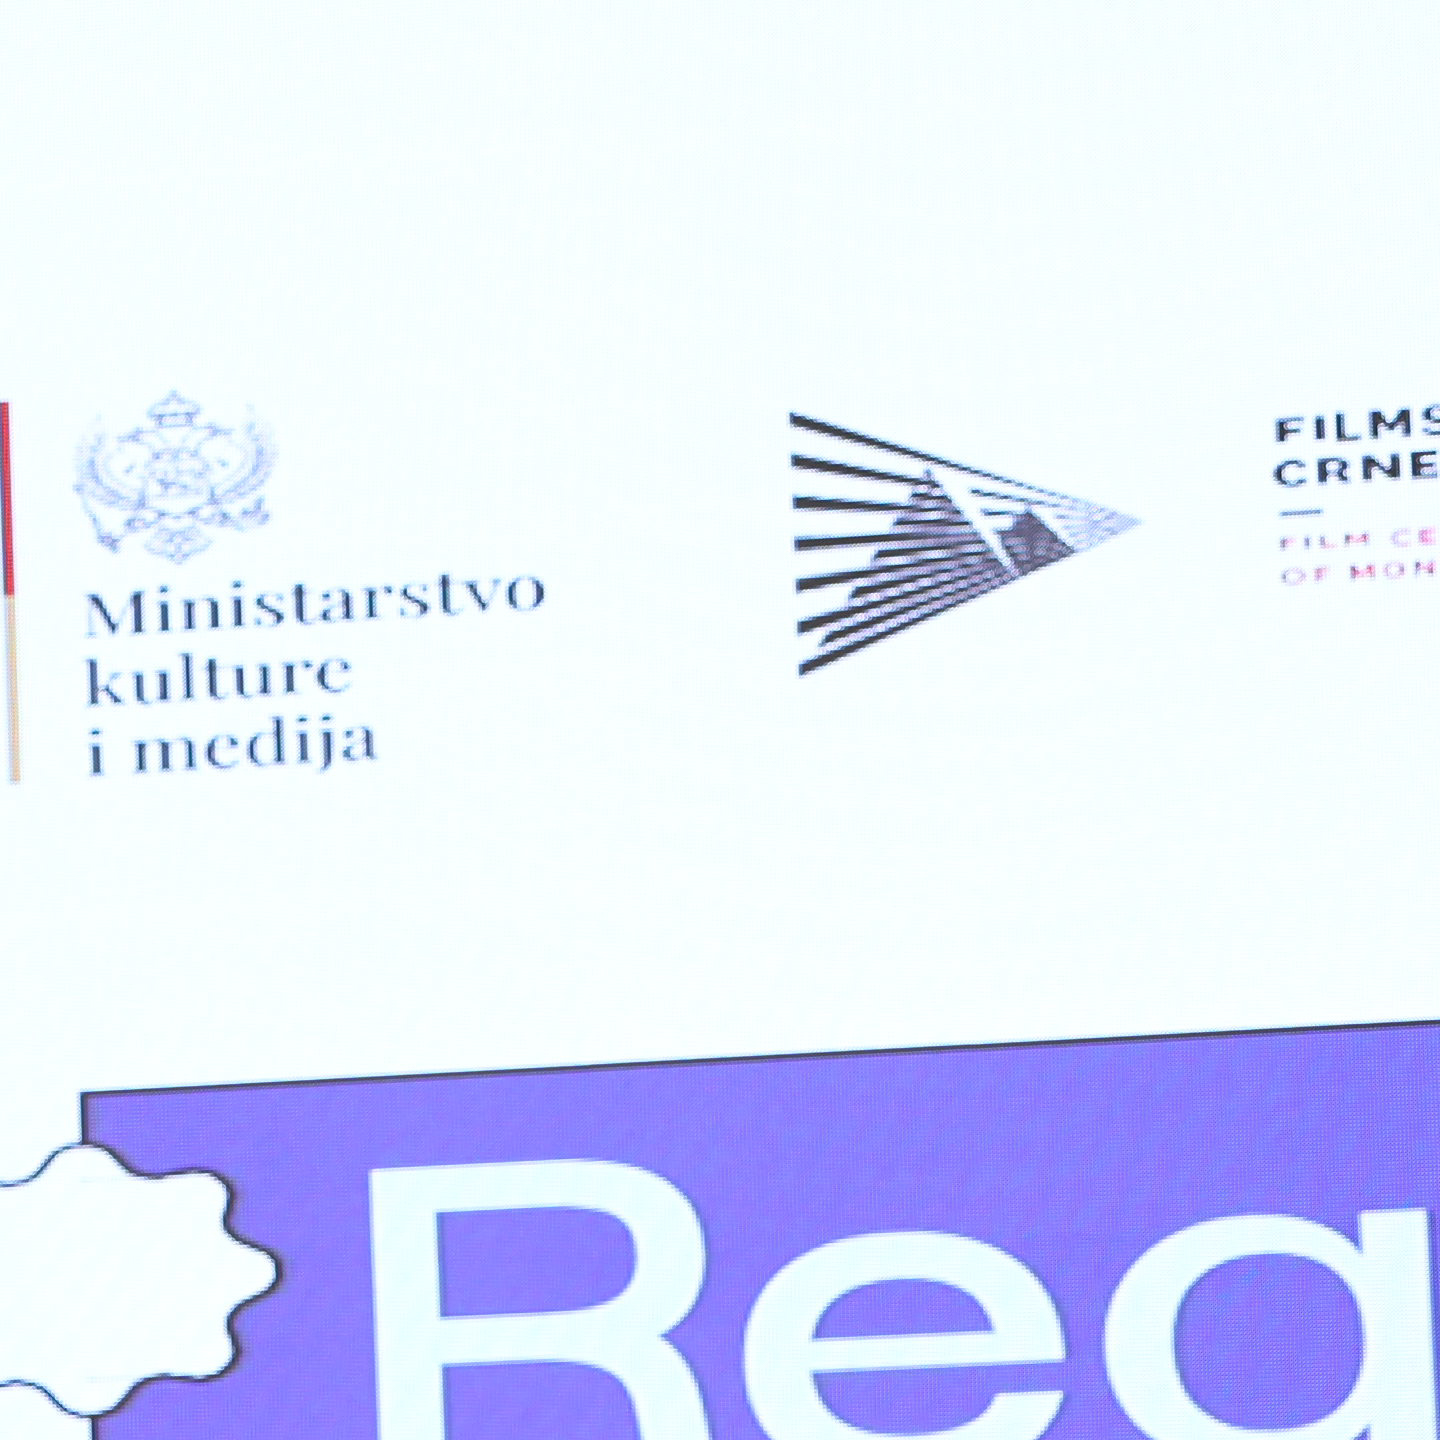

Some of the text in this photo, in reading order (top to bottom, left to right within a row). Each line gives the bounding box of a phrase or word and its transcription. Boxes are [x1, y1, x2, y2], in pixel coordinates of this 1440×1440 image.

[1273, 450, 1438, 487] CRNE
[1279, 532, 1370, 551] FILM
[1281, 565, 1329, 585] OF
[82, 571, 547, 638] Ministarstvo
[85, 652, 353, 706] kulture
[88, 713, 379, 777] i medija
